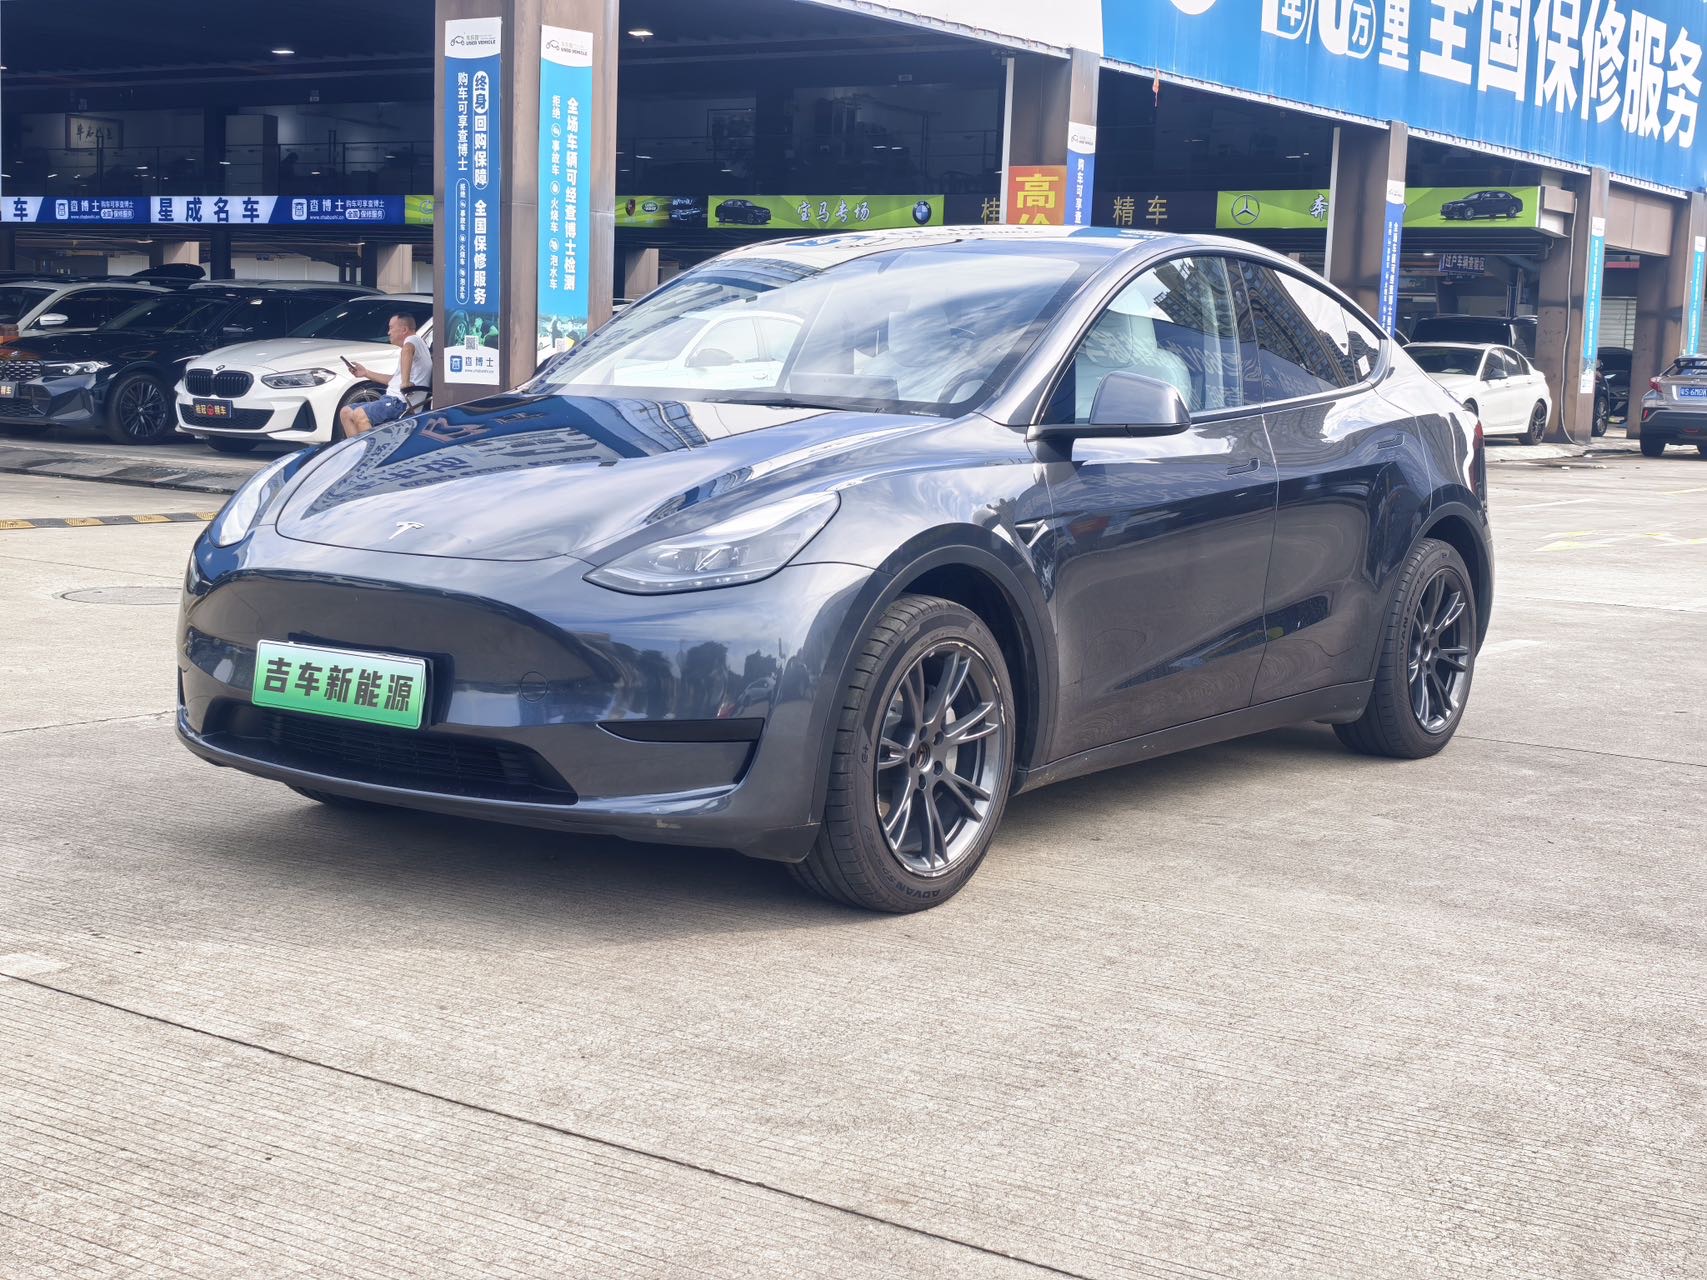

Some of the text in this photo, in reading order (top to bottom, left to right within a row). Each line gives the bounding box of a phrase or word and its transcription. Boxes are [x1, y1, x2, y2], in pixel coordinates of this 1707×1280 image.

[457, 72, 469, 171] 购车可享查博士
[551, 94, 561, 120] 拒绝
[473, 74, 488, 305] 终身回购保障 全国保修服务
[563, 97, 579, 291] 全场车辆可经查博士检测
[13, 197, 28, 221] 车
[158, 196, 260, 223] 星成名车
[550, 197, 559, 233] 火烧车
[797, 199, 871, 223] 宝马专场
[1113, 195, 1168, 226] 精车
[549, 254, 559, 290] 泡水车
[263, 656, 415, 712] 吉车新能源
